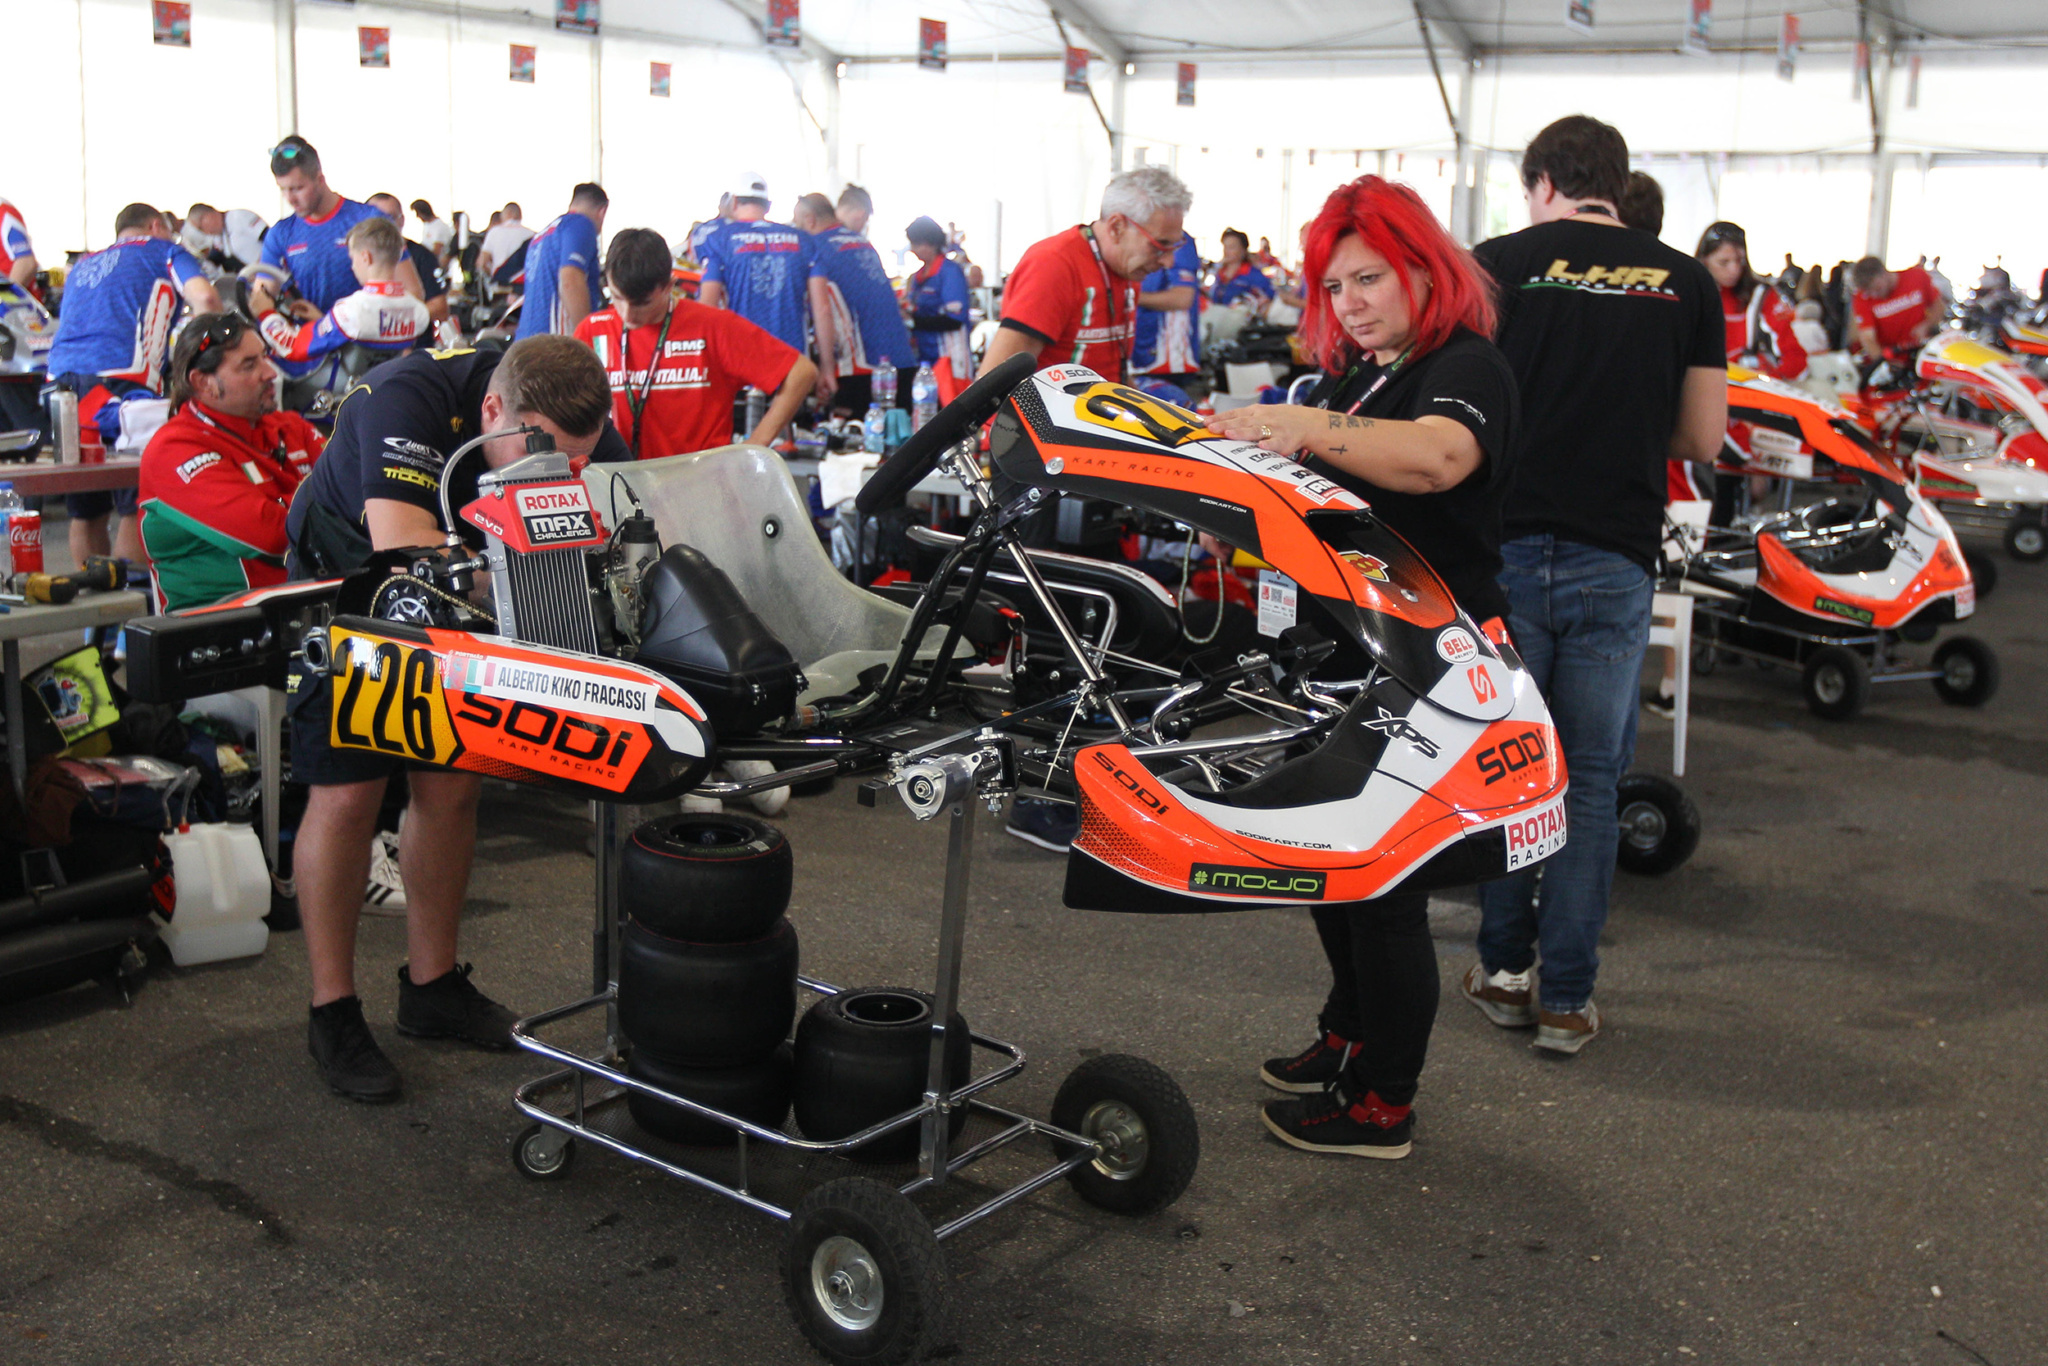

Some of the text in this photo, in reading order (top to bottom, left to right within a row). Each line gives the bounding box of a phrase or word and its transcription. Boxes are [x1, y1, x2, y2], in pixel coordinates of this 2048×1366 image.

[1545, 258, 1671, 288] LHA
[671, 339, 706, 352] RMC
[1072, 456, 1197, 479] KART RACING
[524, 492, 580, 511] ROTAX
[1199, 497, 1248, 514] SODIKART.COM
[530, 512, 590, 534] MAX
[535, 528, 592, 541] CHALLENGE
[1442, 635, 1474, 656] BELL
[333, 636, 436, 761] 226
[497, 666, 648, 712] ALBERTO KIKO FRACASSI
[1360, 706, 1443, 761] XPS
[497, 736, 617, 779] KART RACING
[1507, 802, 1566, 851] ROTAX
[1235, 829, 1333, 850] SODIKART.COM
[1509, 830, 1566, 868] RACING
